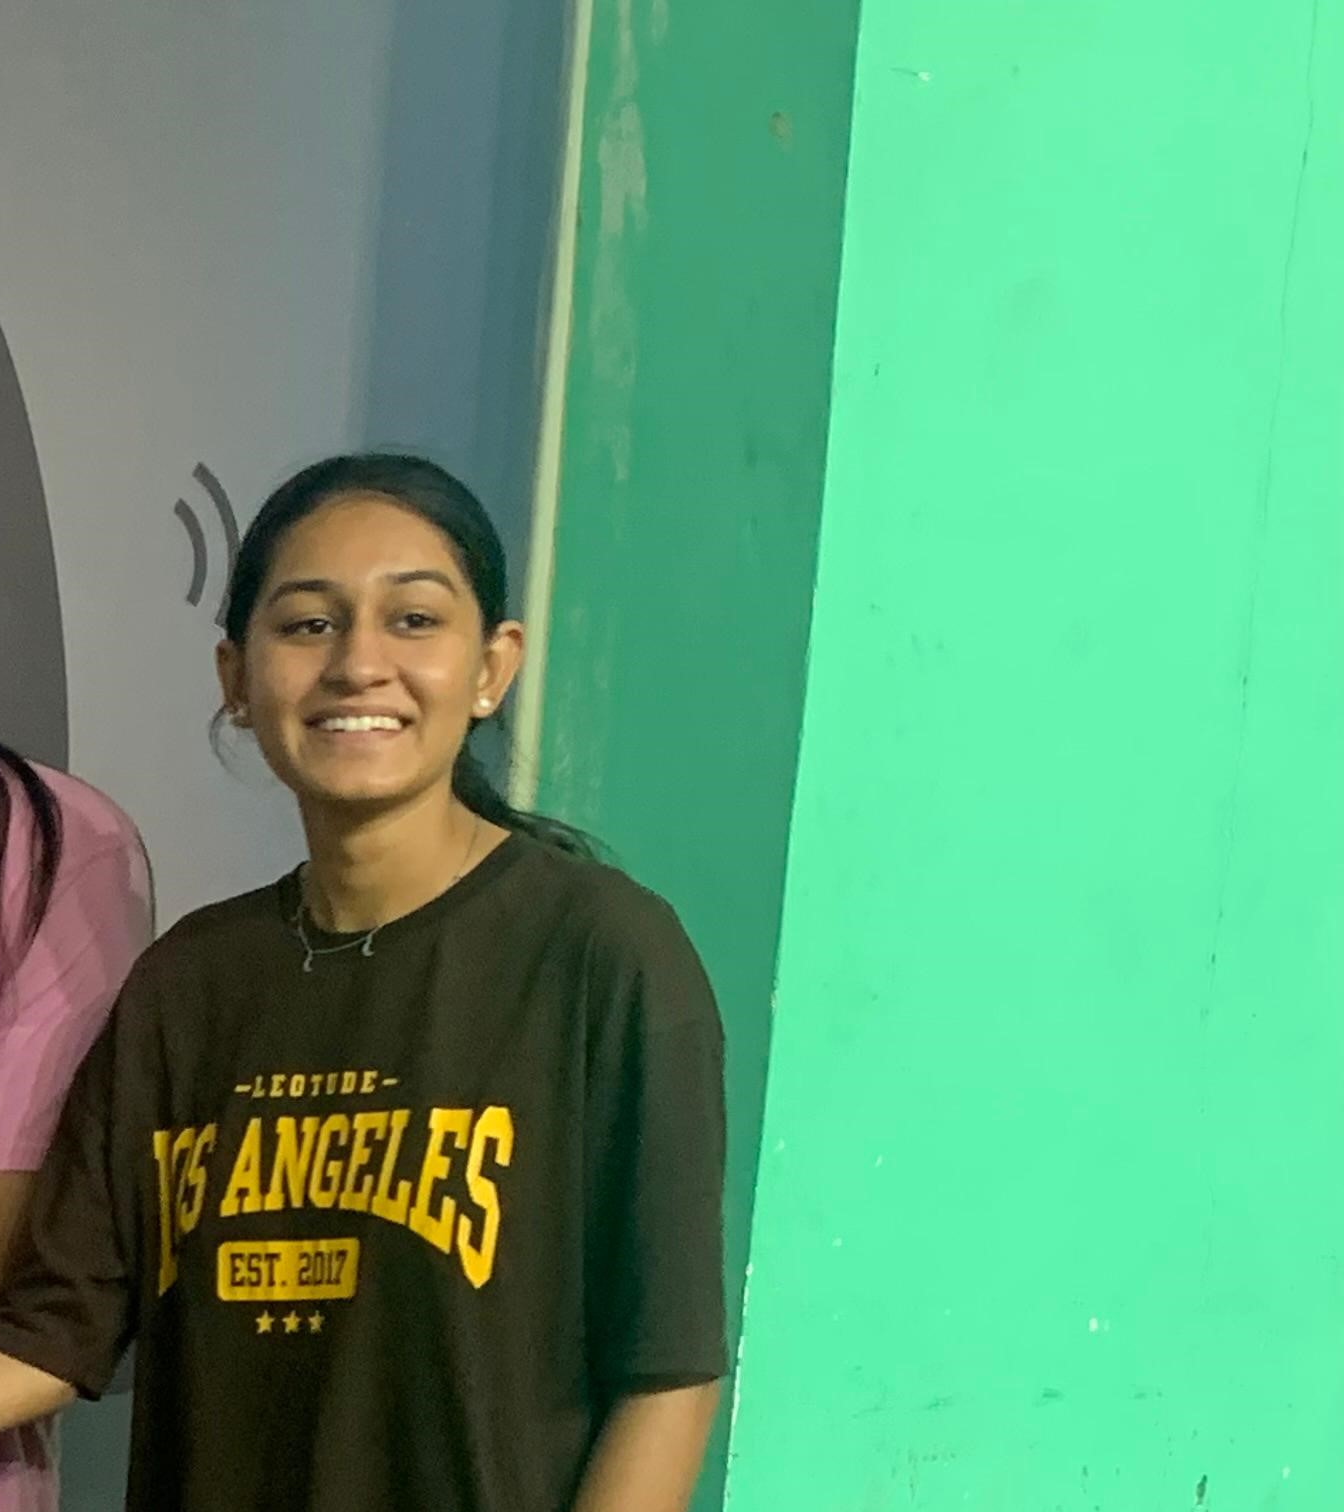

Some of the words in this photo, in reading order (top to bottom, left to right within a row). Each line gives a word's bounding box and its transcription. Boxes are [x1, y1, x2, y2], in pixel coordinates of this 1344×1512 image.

[219, 1105, 514, 1290] ANGELES
[229, 1251, 288, 1289] EST.
[297, 1250, 350, 1287] 2017
